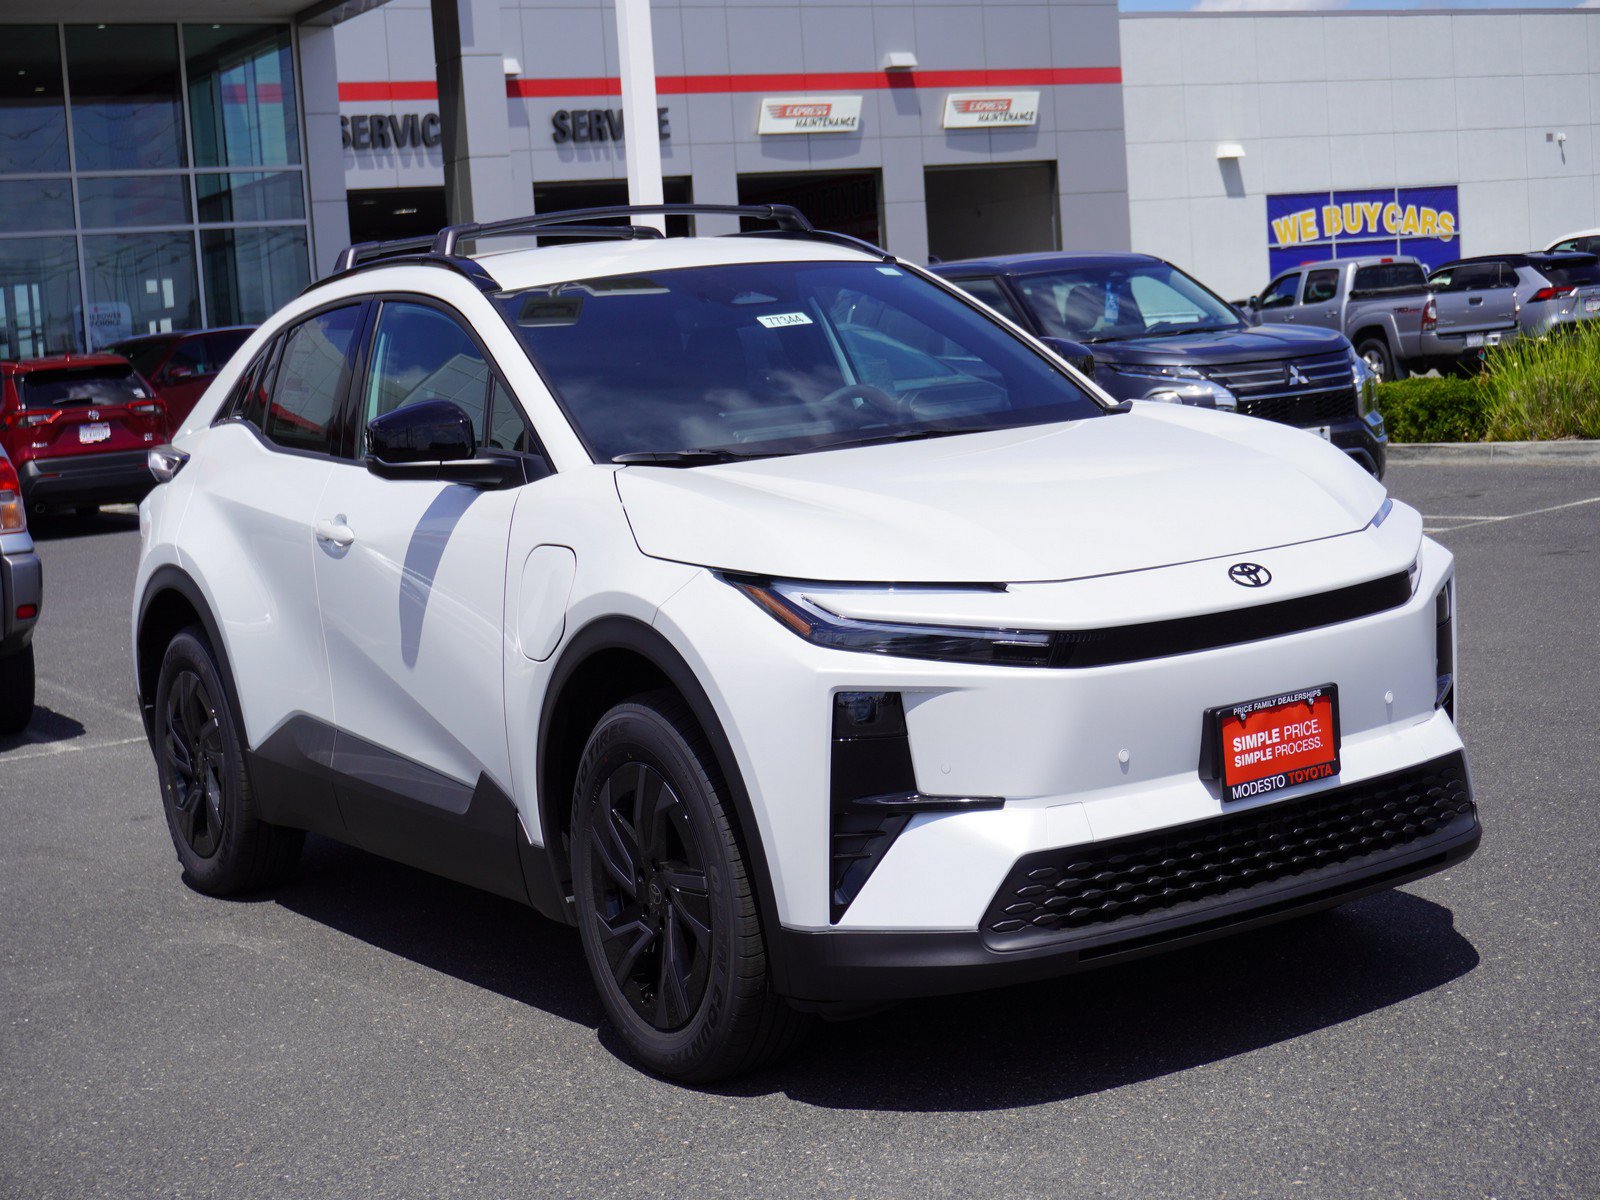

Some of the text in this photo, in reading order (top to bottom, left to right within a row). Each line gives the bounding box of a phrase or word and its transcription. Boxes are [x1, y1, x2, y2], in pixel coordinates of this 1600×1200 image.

[552, 107, 671, 144] SERVE
[785, 104, 829, 117] EXPRESS
[340, 112, 441, 149] SERVIC
[1271, 201, 1455, 246] WE BUY CARS
[766, 315, 804, 326] 77344
[1233, 689, 1321, 715] PRICE FAMILY DEALERSHIPS
[1232, 719, 1322, 752] SIMPLE PRICE.
[1234, 736, 1323, 767] SIMPLE PROCESS.
[1232, 763, 1333, 800] MODESTO TOYOTA
